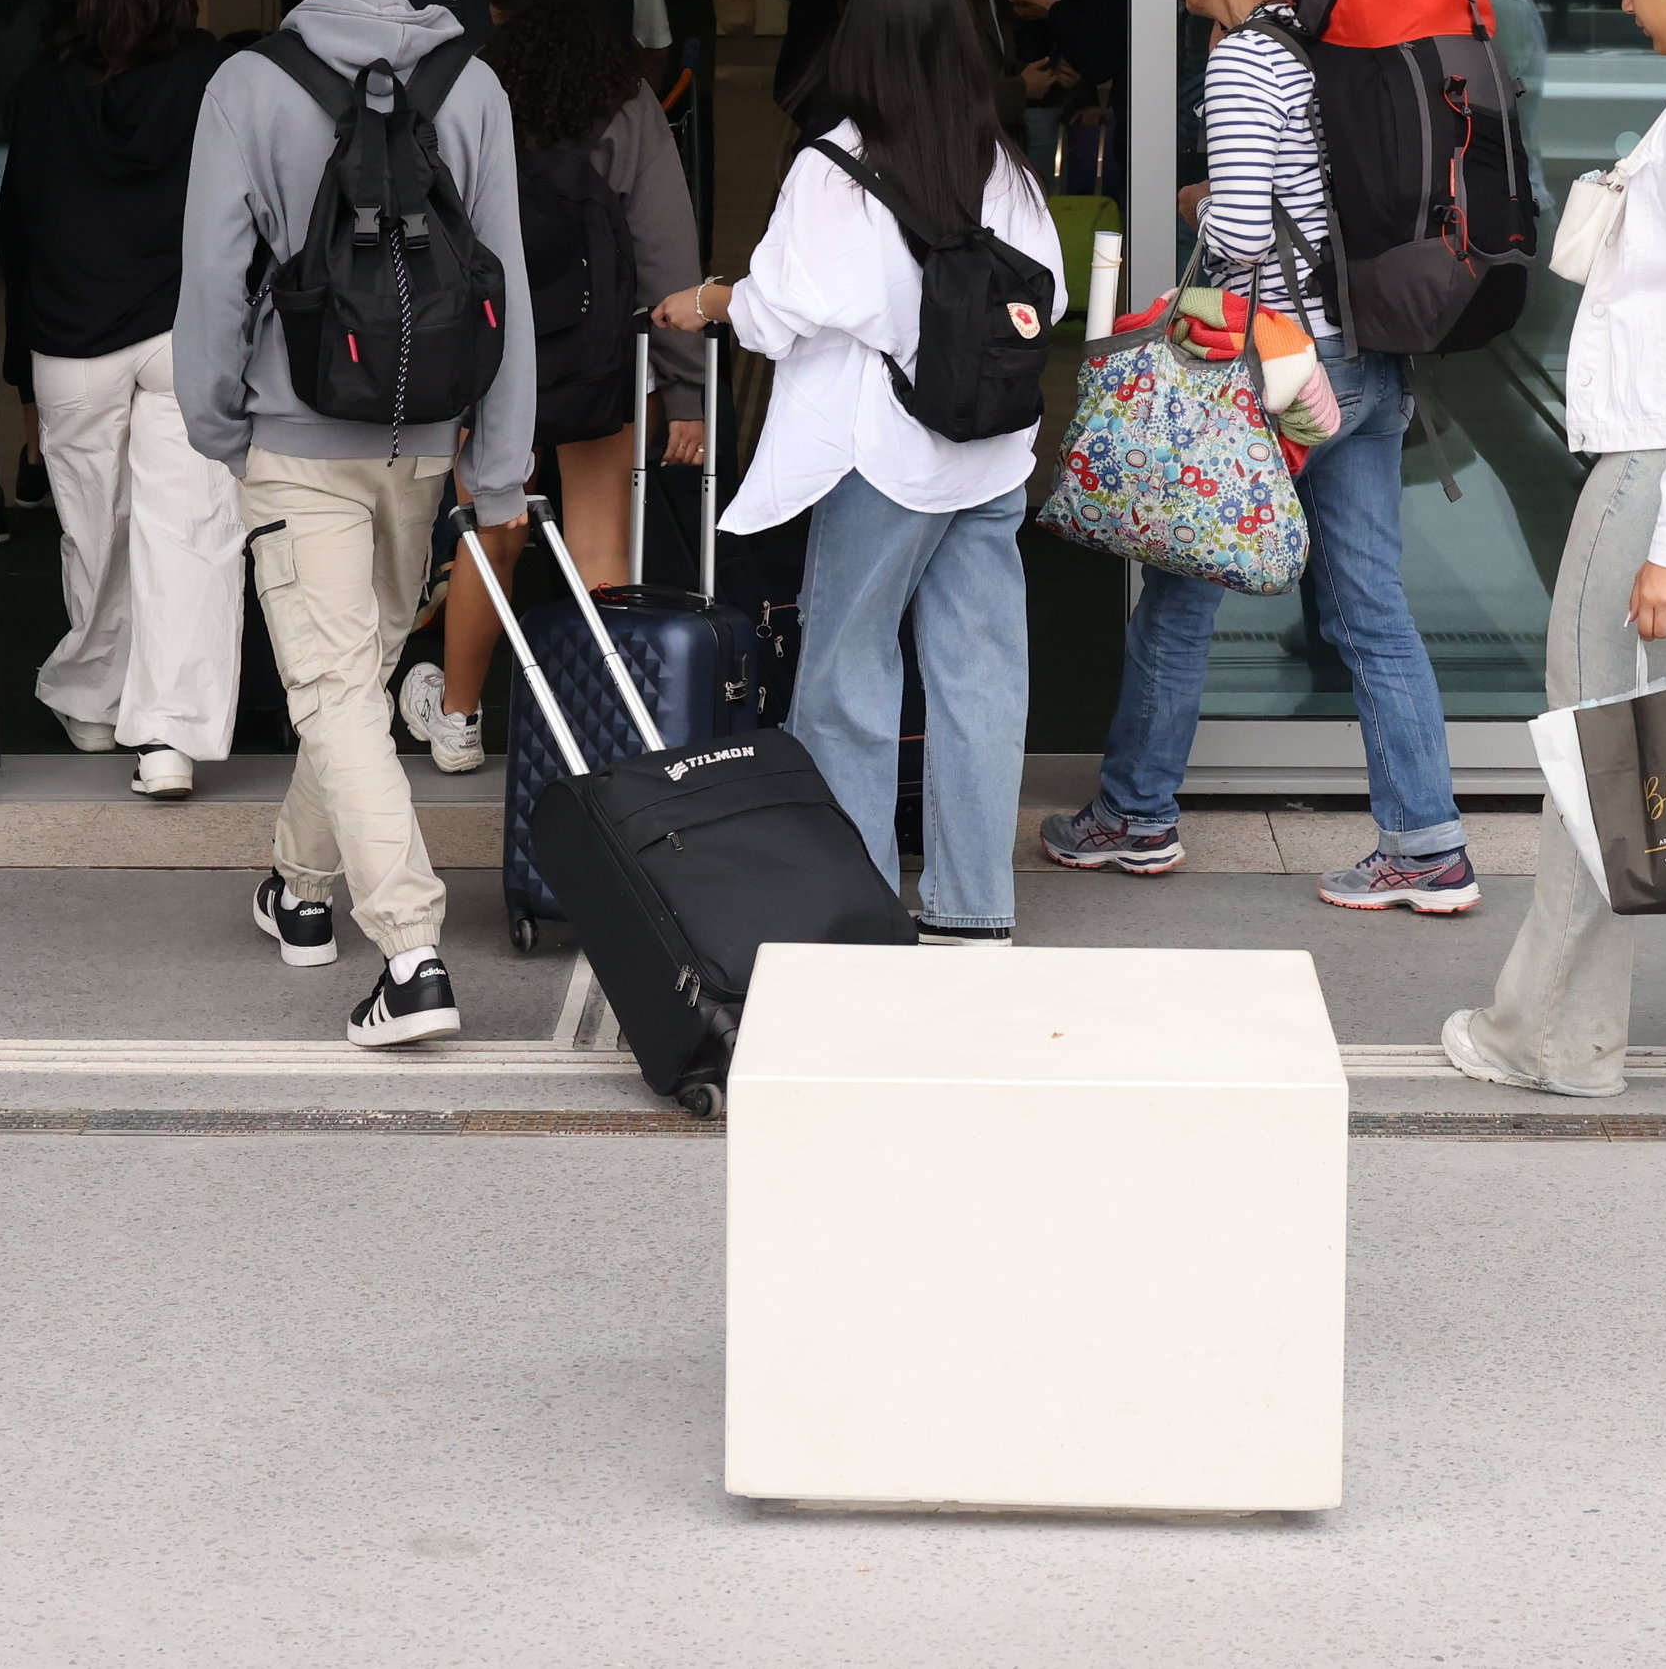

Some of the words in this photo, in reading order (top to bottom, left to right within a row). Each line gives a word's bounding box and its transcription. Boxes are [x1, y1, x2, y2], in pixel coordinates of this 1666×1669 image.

[685, 746, 755, 768] TILMON
[299, 906, 325, 917] adidas
[419, 967, 446, 979] adidas
